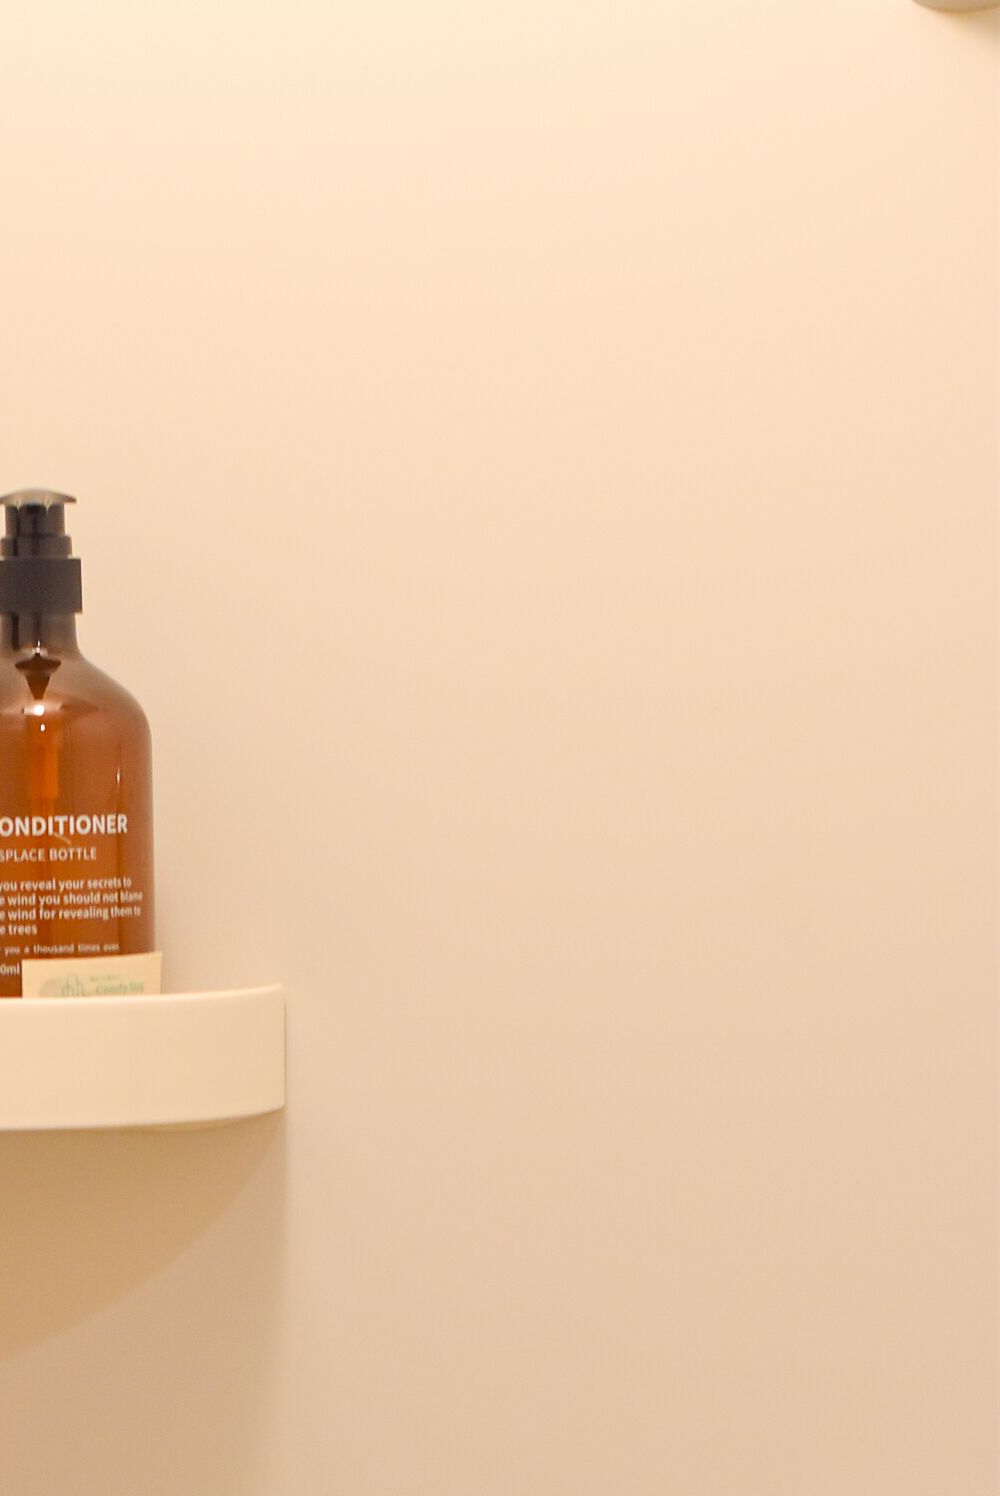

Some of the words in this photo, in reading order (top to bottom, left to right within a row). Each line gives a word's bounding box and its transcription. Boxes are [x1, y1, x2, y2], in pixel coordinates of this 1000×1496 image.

[50, 847, 97, 861] BOTTLE
[20, 878, 55, 890] reveal
[59, 879, 84, 892] your
[87, 878, 121, 889] secrets
[123, 877, 131, 887] to
[8, 894, 35, 905] wind
[39, 895, 60, 909] you
[63, 892, 100, 905] should
[102, 891, 118, 903] not
[8, 908, 36, 920] wind
[39, 908, 55, 920] for
[59, 907, 109, 920] revealing
[110, 905, 133, 917] them
[8, 925, 37, 935] trees
[5, 945, 20, 957] you
[34, 943, 74, 954] thousand
